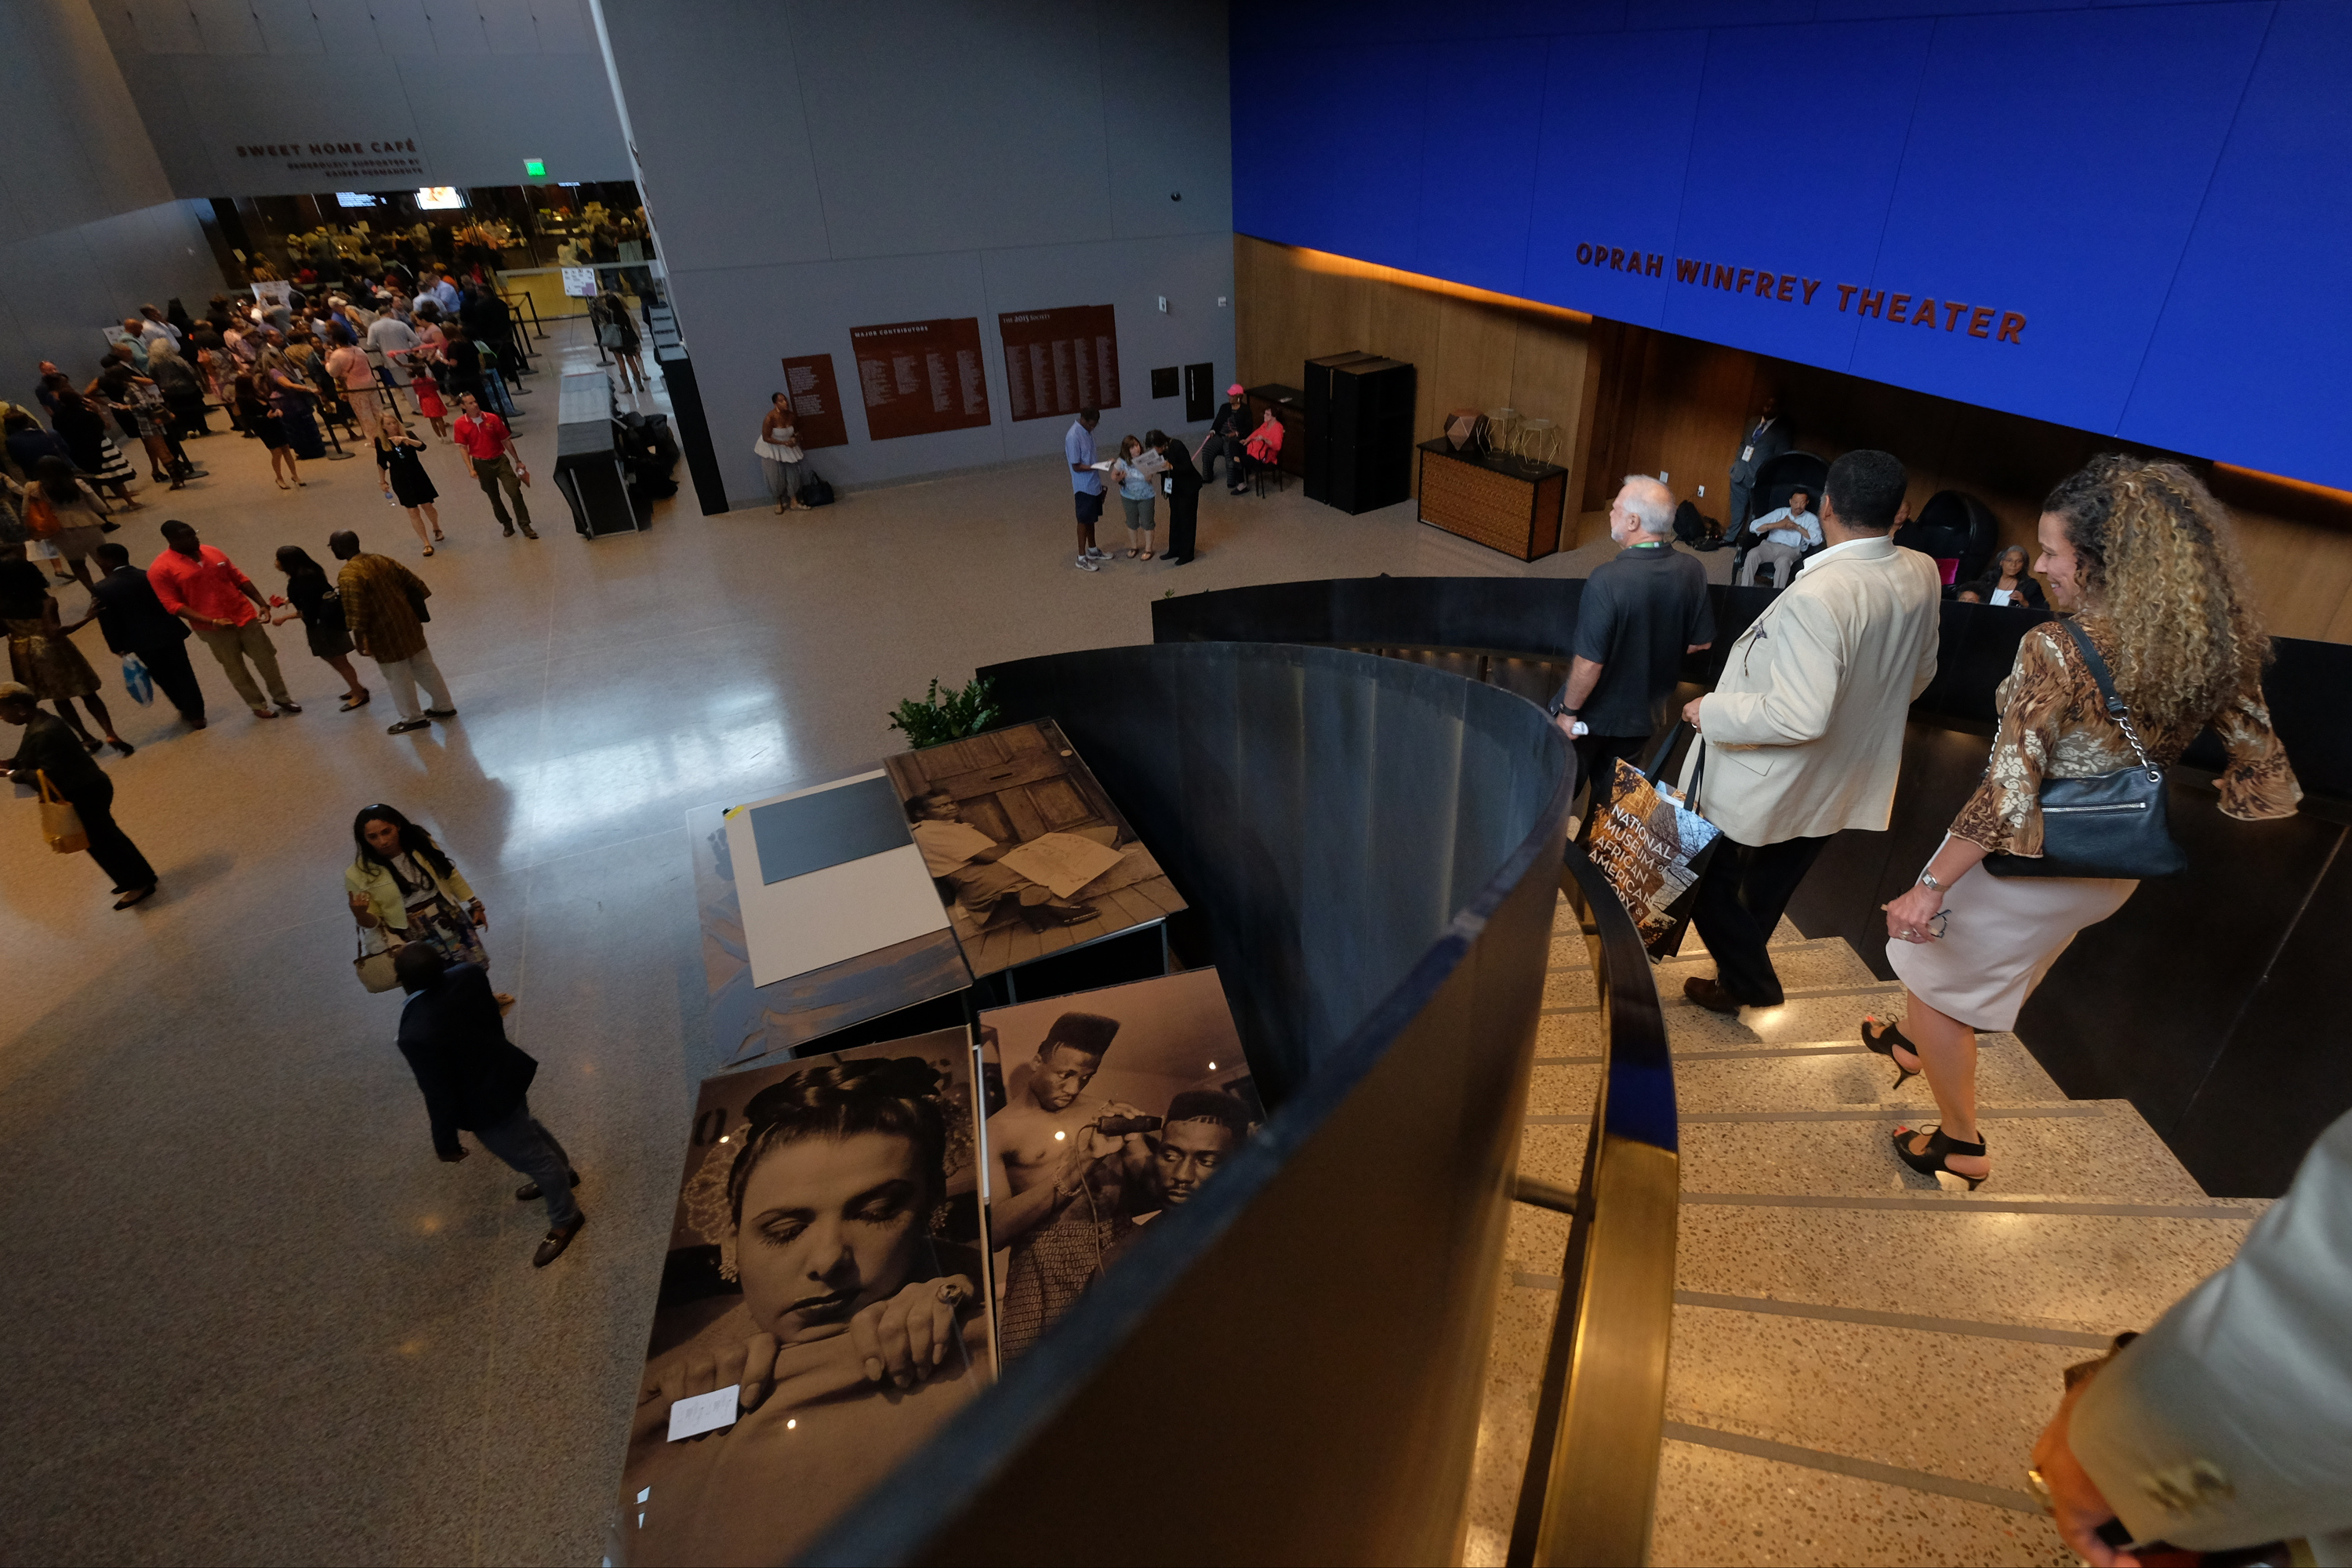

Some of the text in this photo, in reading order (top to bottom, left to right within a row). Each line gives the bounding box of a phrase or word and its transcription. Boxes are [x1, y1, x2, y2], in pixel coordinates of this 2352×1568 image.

[236, 137, 417, 158] SWEET HOME CAFÉ
[1576, 241, 2027, 345] OPRAH WINFREY THEATER
[879, 325, 929, 336] CONTRIBUTORS
[1595, 834, 1649, 884] AFRICAN
[1603, 818, 1671, 874] MUSEUM of
[1611, 804, 1673, 861] NATIONAL
[1588, 849, 1655, 906] AMERICAN
